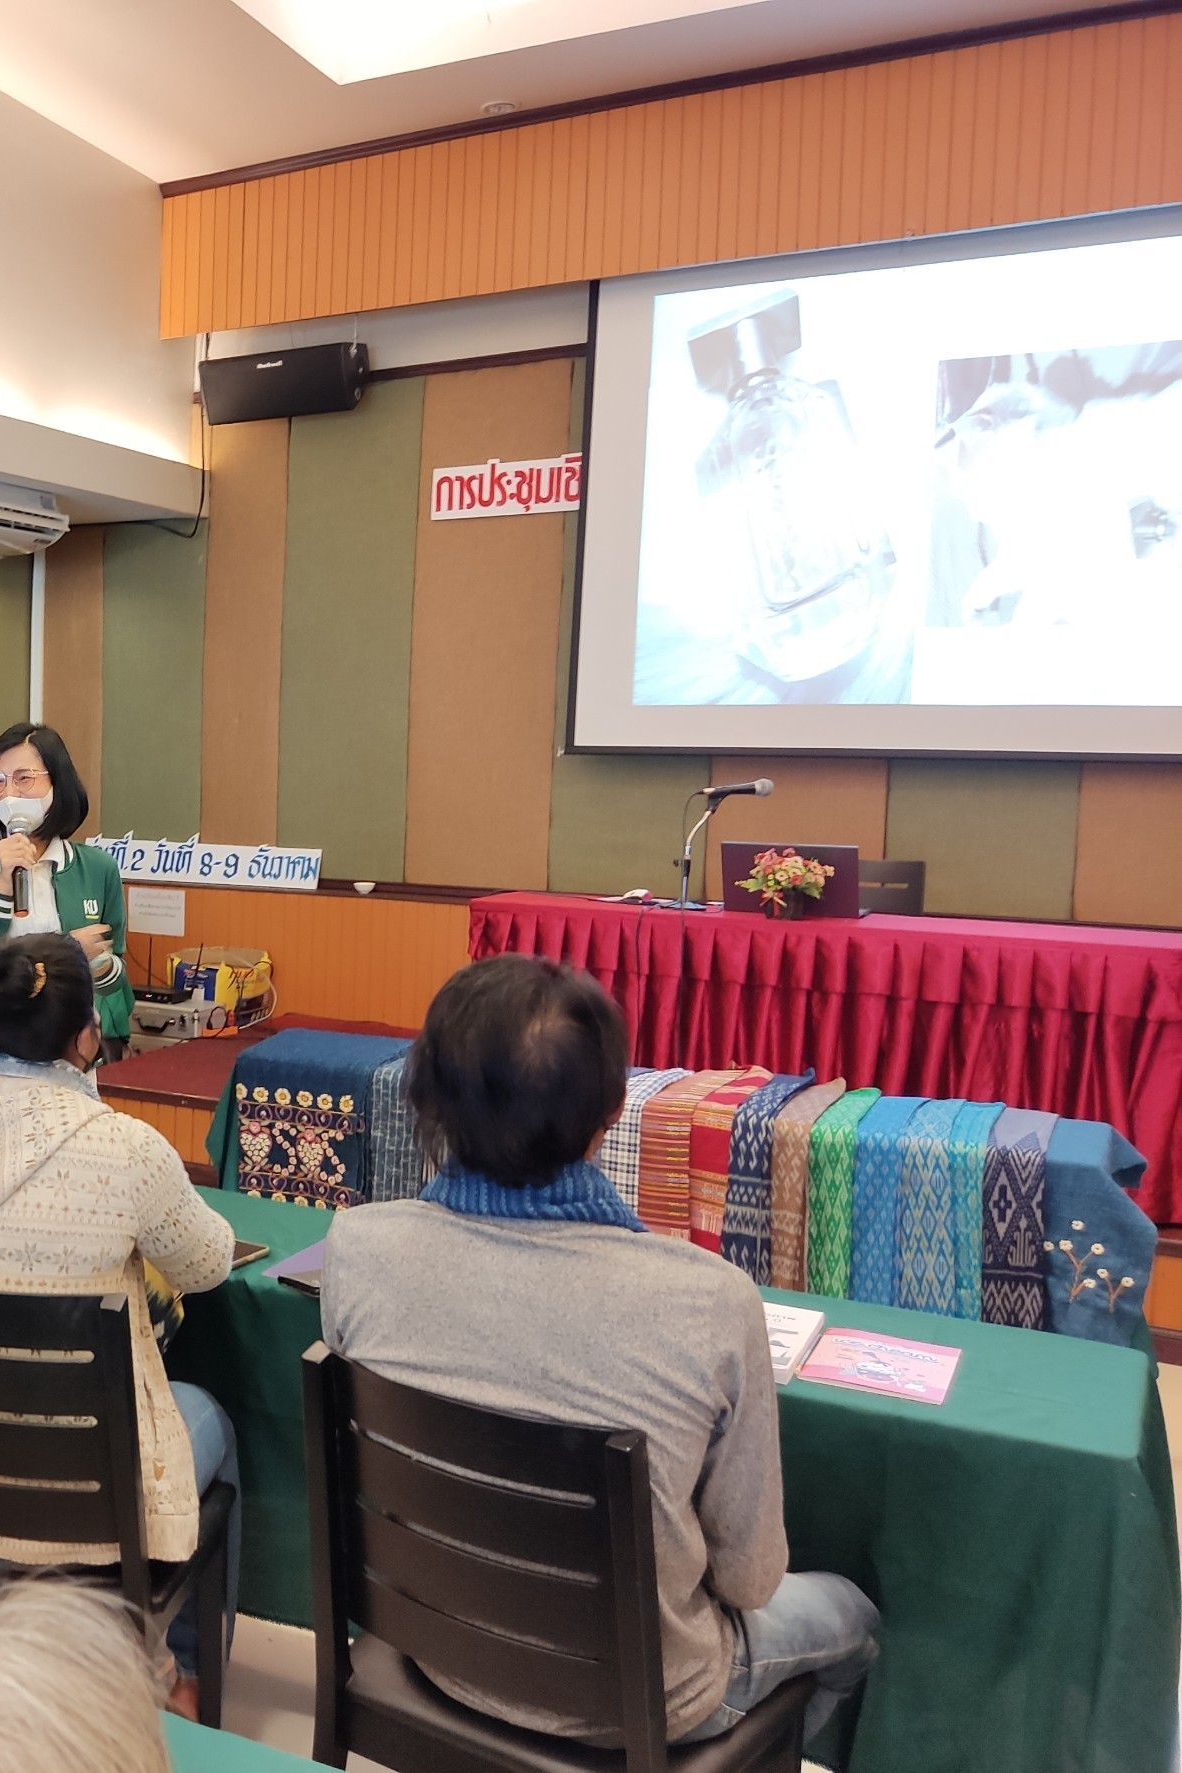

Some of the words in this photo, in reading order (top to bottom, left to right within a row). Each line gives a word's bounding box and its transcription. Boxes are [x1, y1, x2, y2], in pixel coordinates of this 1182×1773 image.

[150, 836, 195, 875] วันที่
[199, 852, 240, 879] 8-9
[248, 847, 320, 880] ธันวาคม
[83, 899, 99, 915] KU
